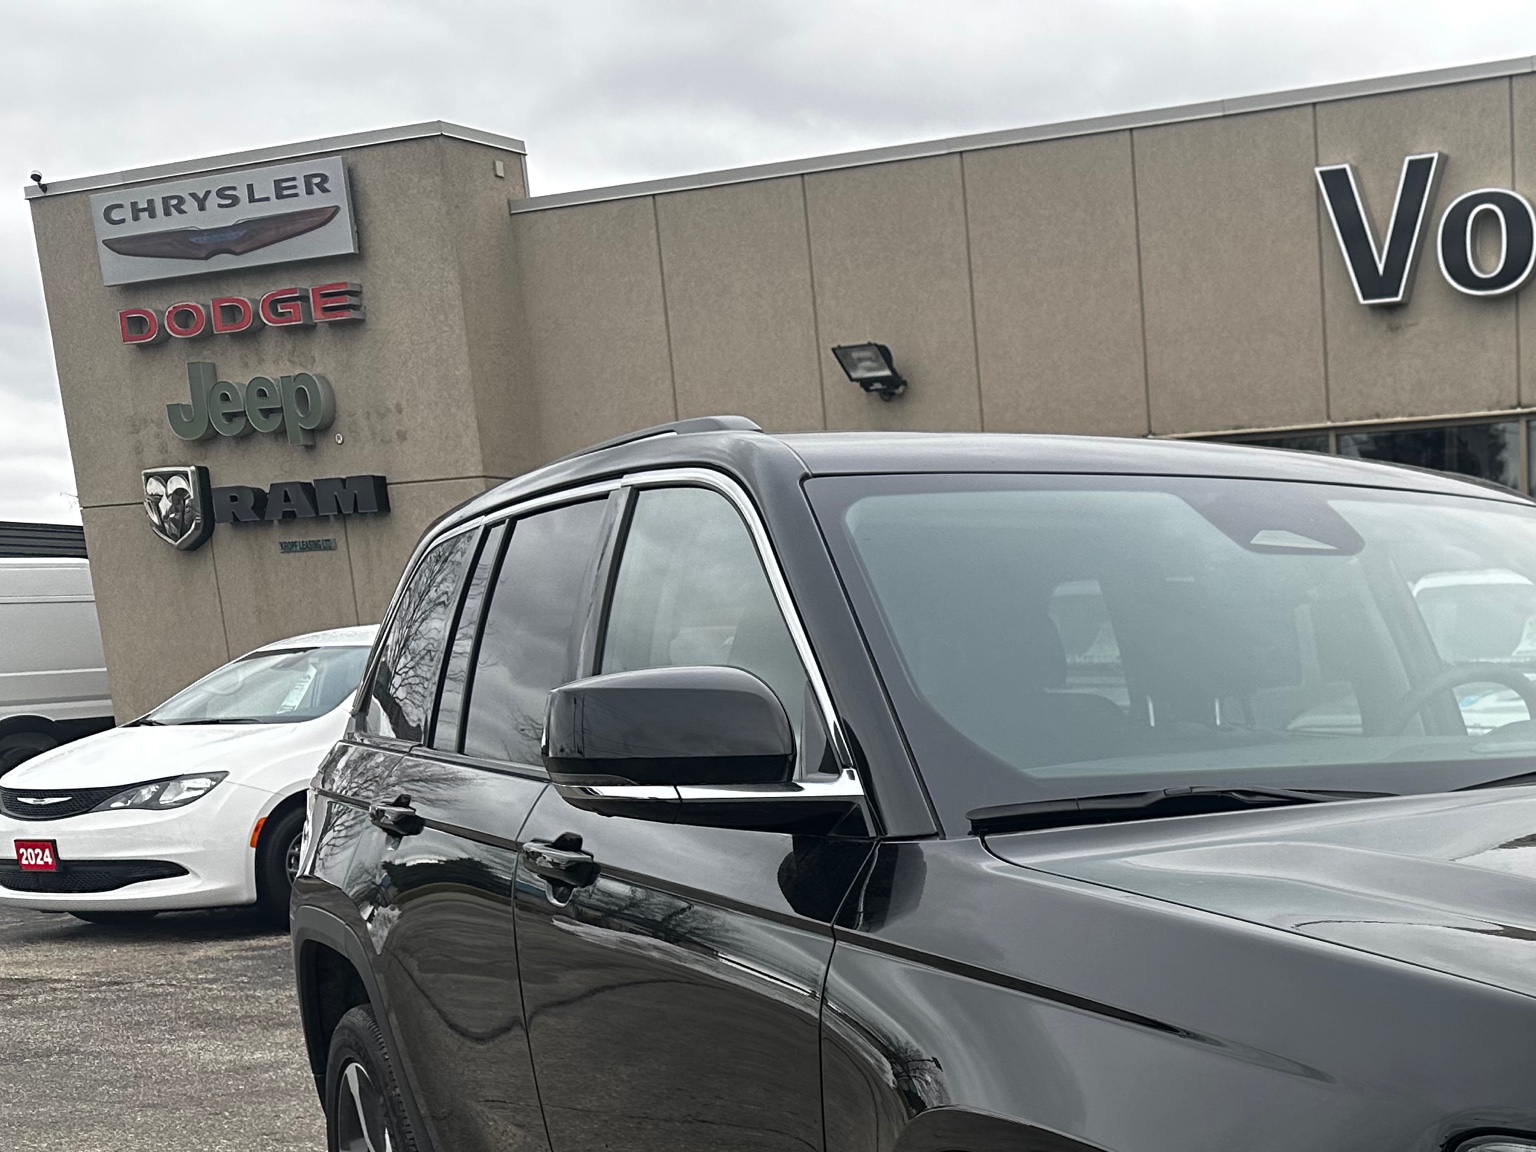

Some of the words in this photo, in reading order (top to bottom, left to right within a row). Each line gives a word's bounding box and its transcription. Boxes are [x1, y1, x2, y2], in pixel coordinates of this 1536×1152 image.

[103, 172, 331, 226] CHRYSLER
[118, 282, 358, 344] DODGE
[166, 361, 330, 446] Jeep
[213, 476, 388, 523] RAM
[19, 848, 53, 865] 2024
